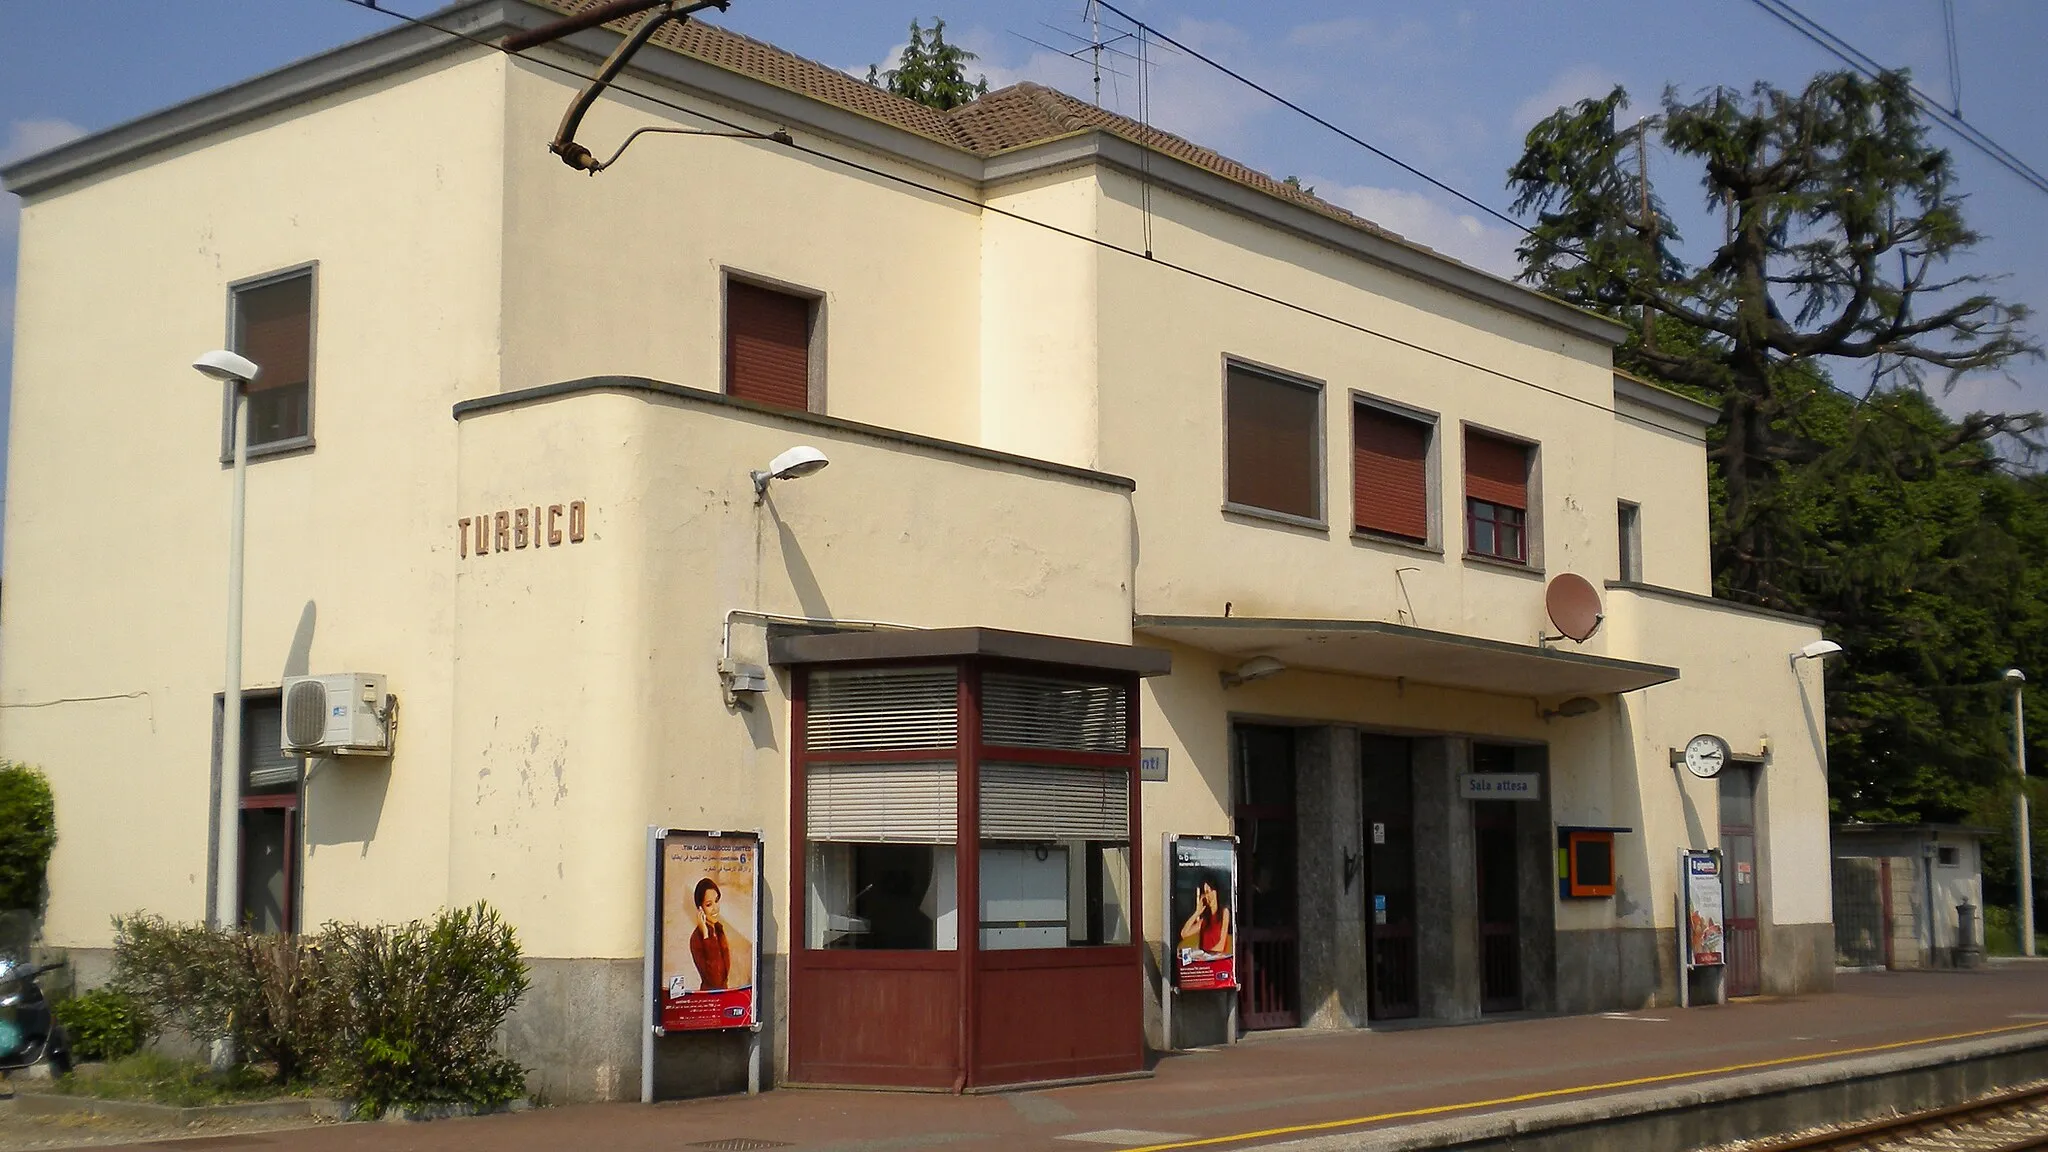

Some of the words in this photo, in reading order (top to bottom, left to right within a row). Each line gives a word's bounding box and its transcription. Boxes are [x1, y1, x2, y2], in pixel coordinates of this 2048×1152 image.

[1470, 779, 1491, 791] Sala
[1496, 780, 1528, 791] attesa
[740, 853, 747, 864] 6
[733, 1008, 743, 1016] TIM
